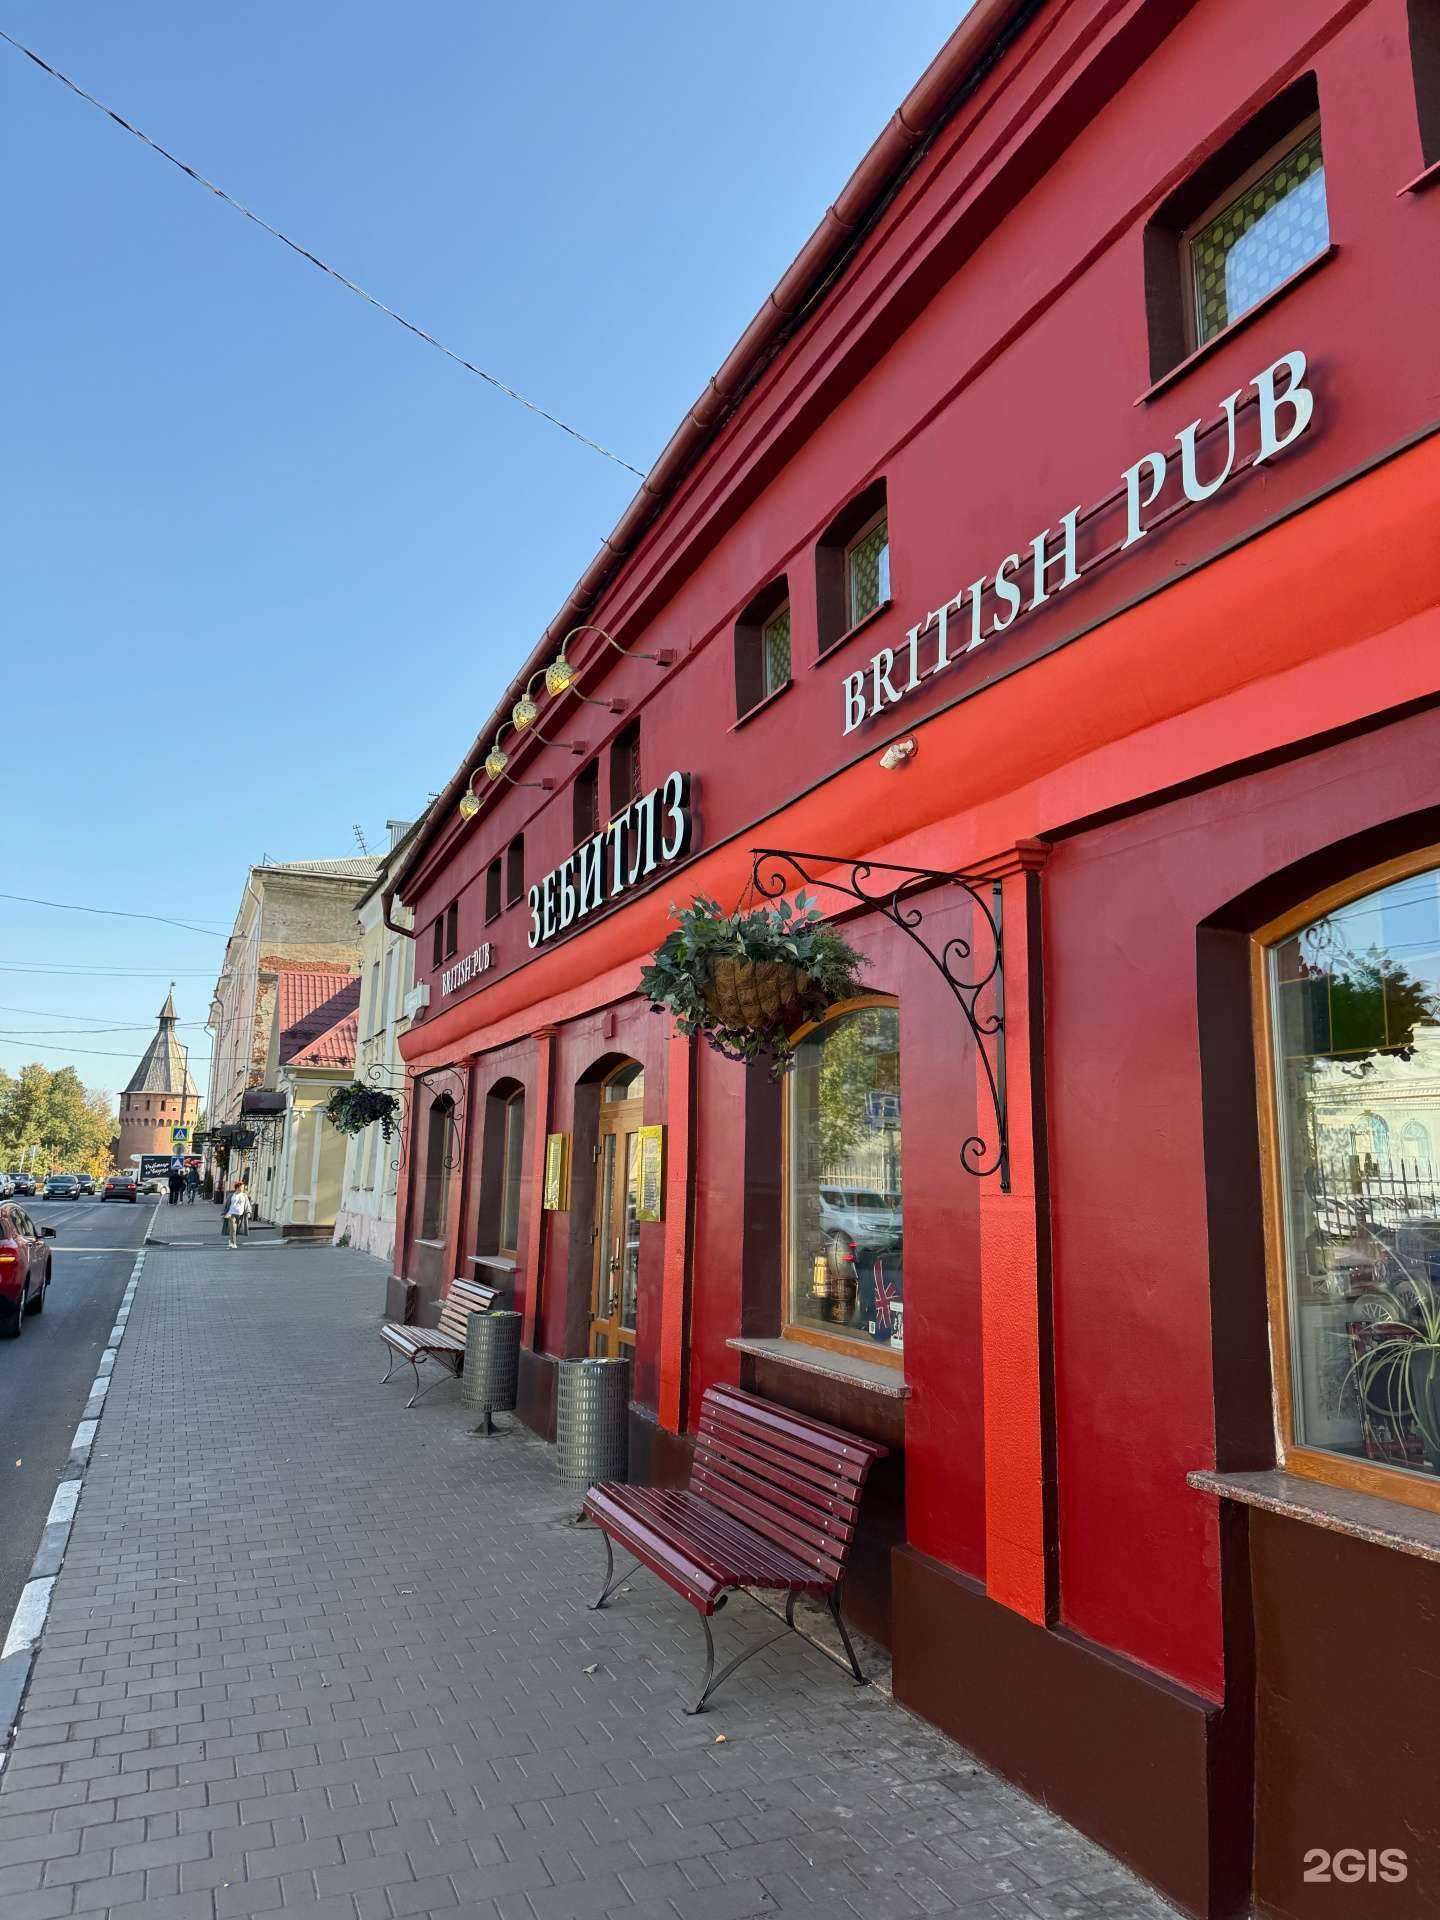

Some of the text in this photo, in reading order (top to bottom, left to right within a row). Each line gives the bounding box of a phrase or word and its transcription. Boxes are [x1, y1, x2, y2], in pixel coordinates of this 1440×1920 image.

[842, 350, 1314, 736] BRITISH PUB
[527, 770, 686, 949] ЗЕБИТЛЗ
[442, 942, 490, 997] BRITISH PUB
